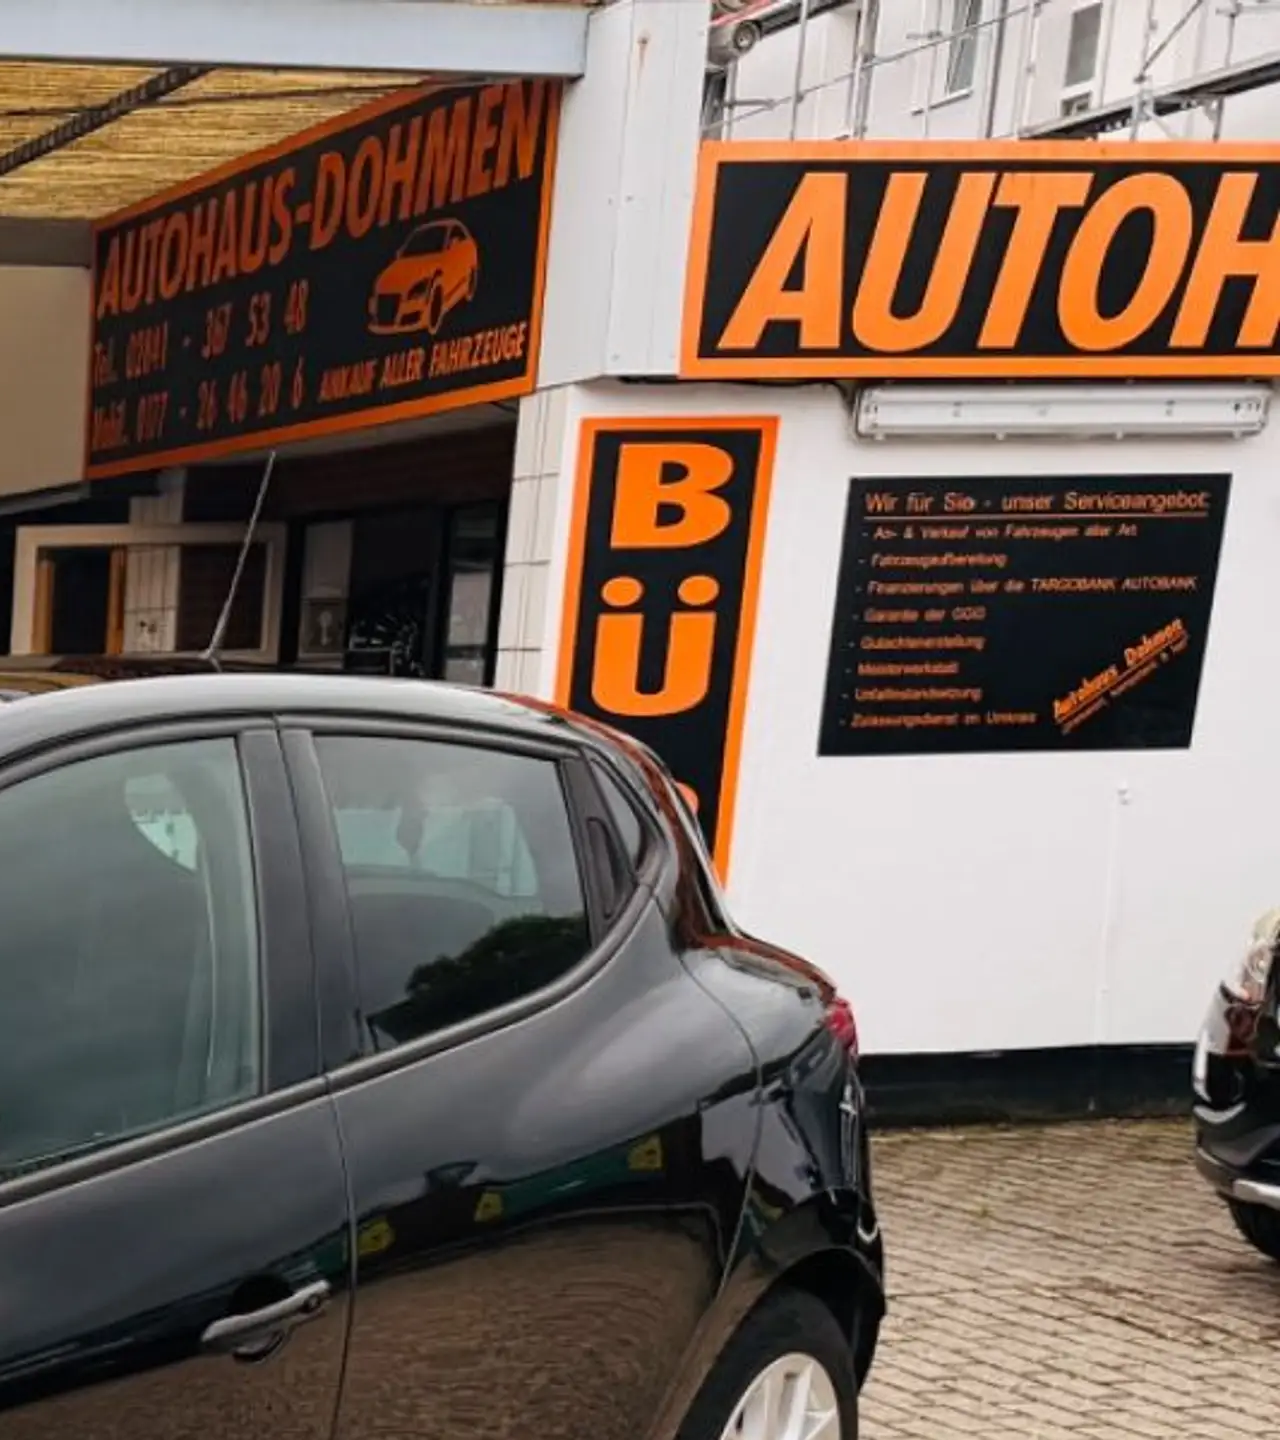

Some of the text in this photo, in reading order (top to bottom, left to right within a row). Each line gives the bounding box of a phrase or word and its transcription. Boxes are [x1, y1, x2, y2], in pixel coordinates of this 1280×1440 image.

[96, 78, 541, 320] AUTOHAUS-DOHMEN
[717, 171, 1280, 352] AUTOH
[429, 320, 529, 376] FAHRZEUGE
[865, 492, 898, 512] Wir
[906, 491, 934, 512] für
[1001, 494, 1052, 511] unser
[590, 443, 735, 815] BÜ
